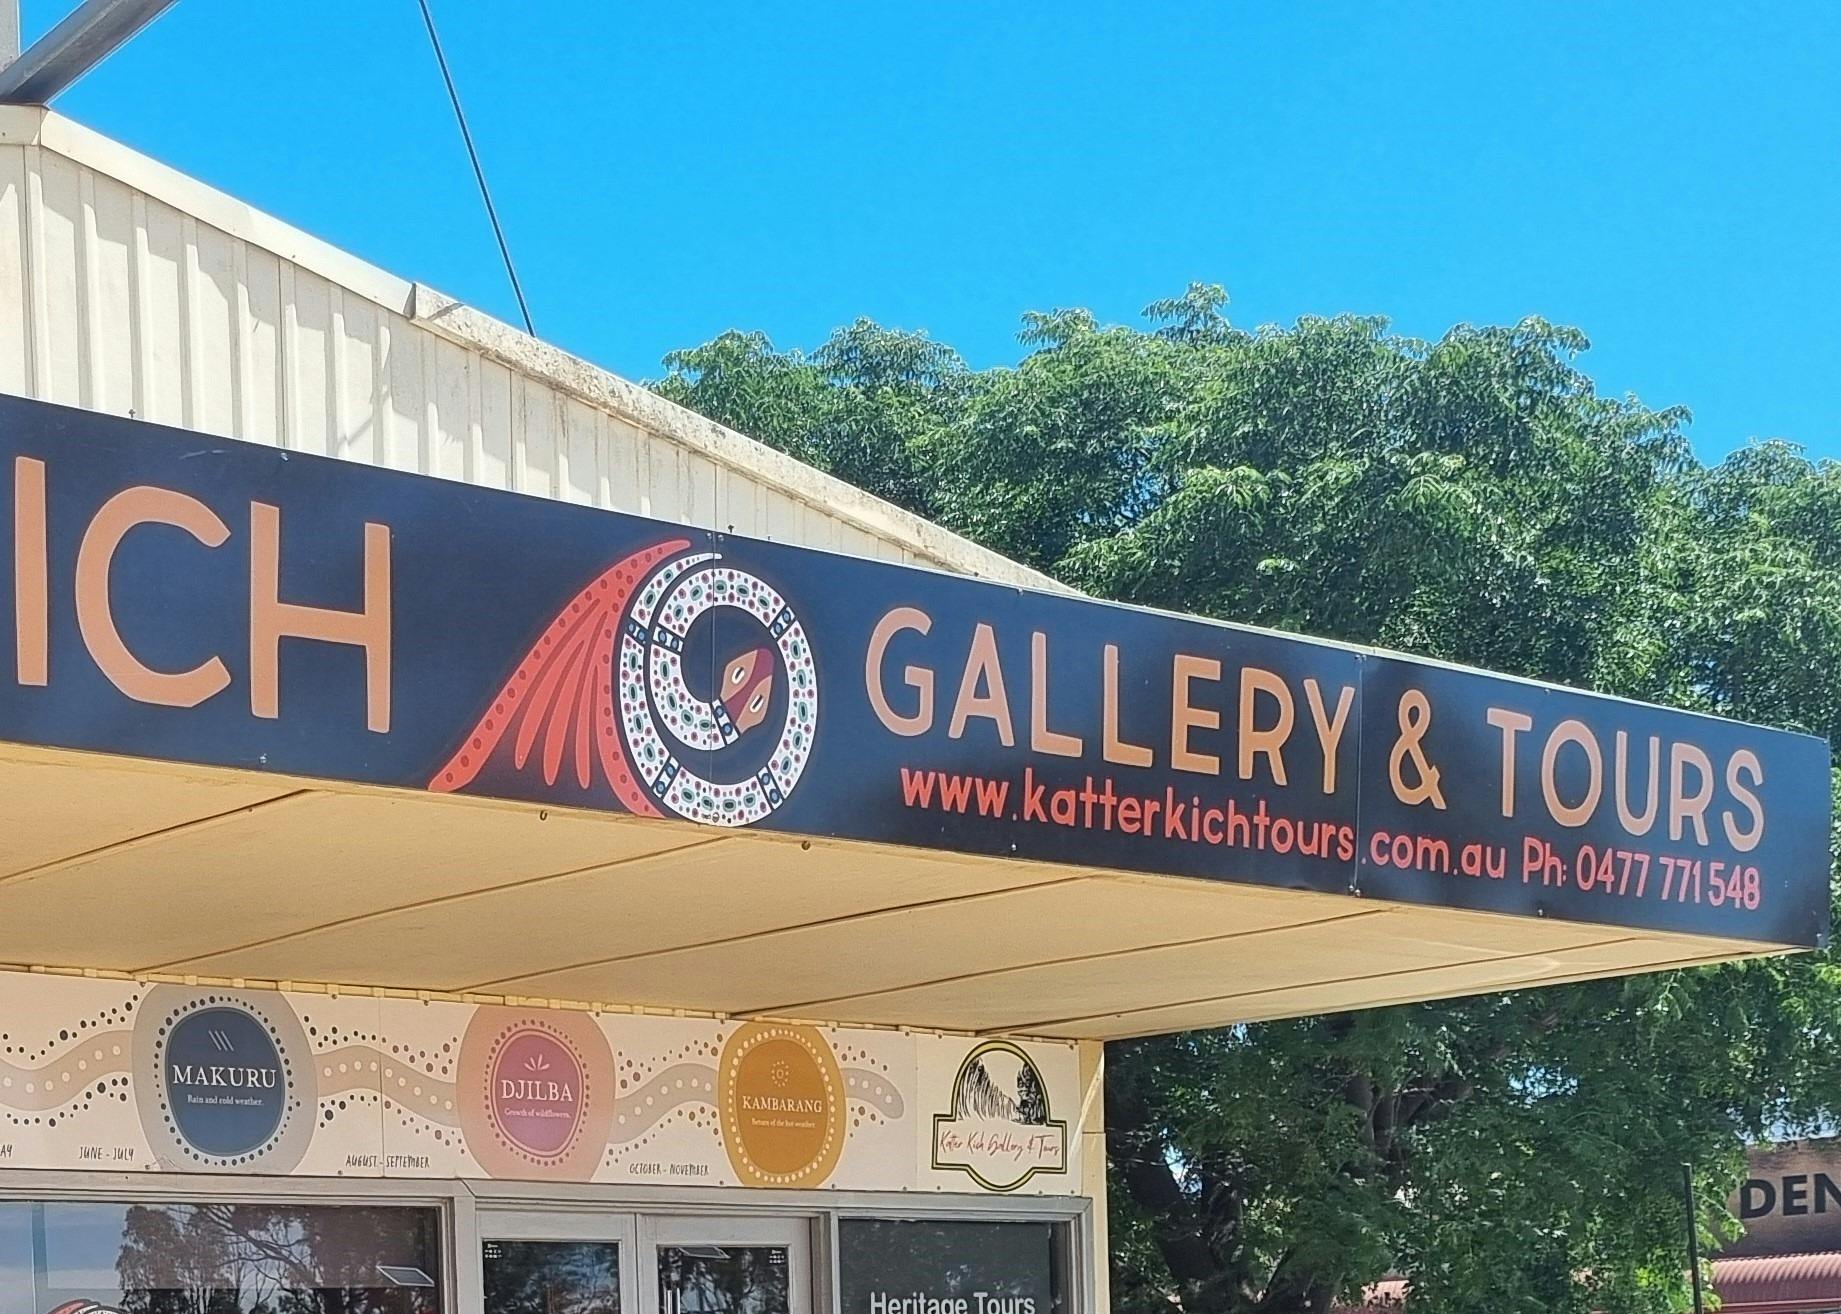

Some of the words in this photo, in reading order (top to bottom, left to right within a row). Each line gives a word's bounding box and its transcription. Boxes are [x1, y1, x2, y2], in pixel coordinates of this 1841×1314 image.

[866, 607, 1355, 794] GALLERY
[1389, 689, 1446, 810] &
[1487, 707, 1764, 852] TOURS
[900, 767, 1505, 879] www.katterkichtours.com.au
[1522, 836, 1567, 887] Ph:
[1576, 845, 1650, 897] 0477
[173, 1064, 277, 1088] MAKURU
[205, 1095, 217, 1104] and
[501, 1080, 573, 1101] DJILBA
[743, 1095, 822, 1113] KAMBARANG
[80, 1146, 102, 1160] JUNE
[113, 1147, 134, 1161] JULY
[345, 1155, 377, 1168] AUGUST
[386, 1154, 430, 1168] SEPTEMBER
